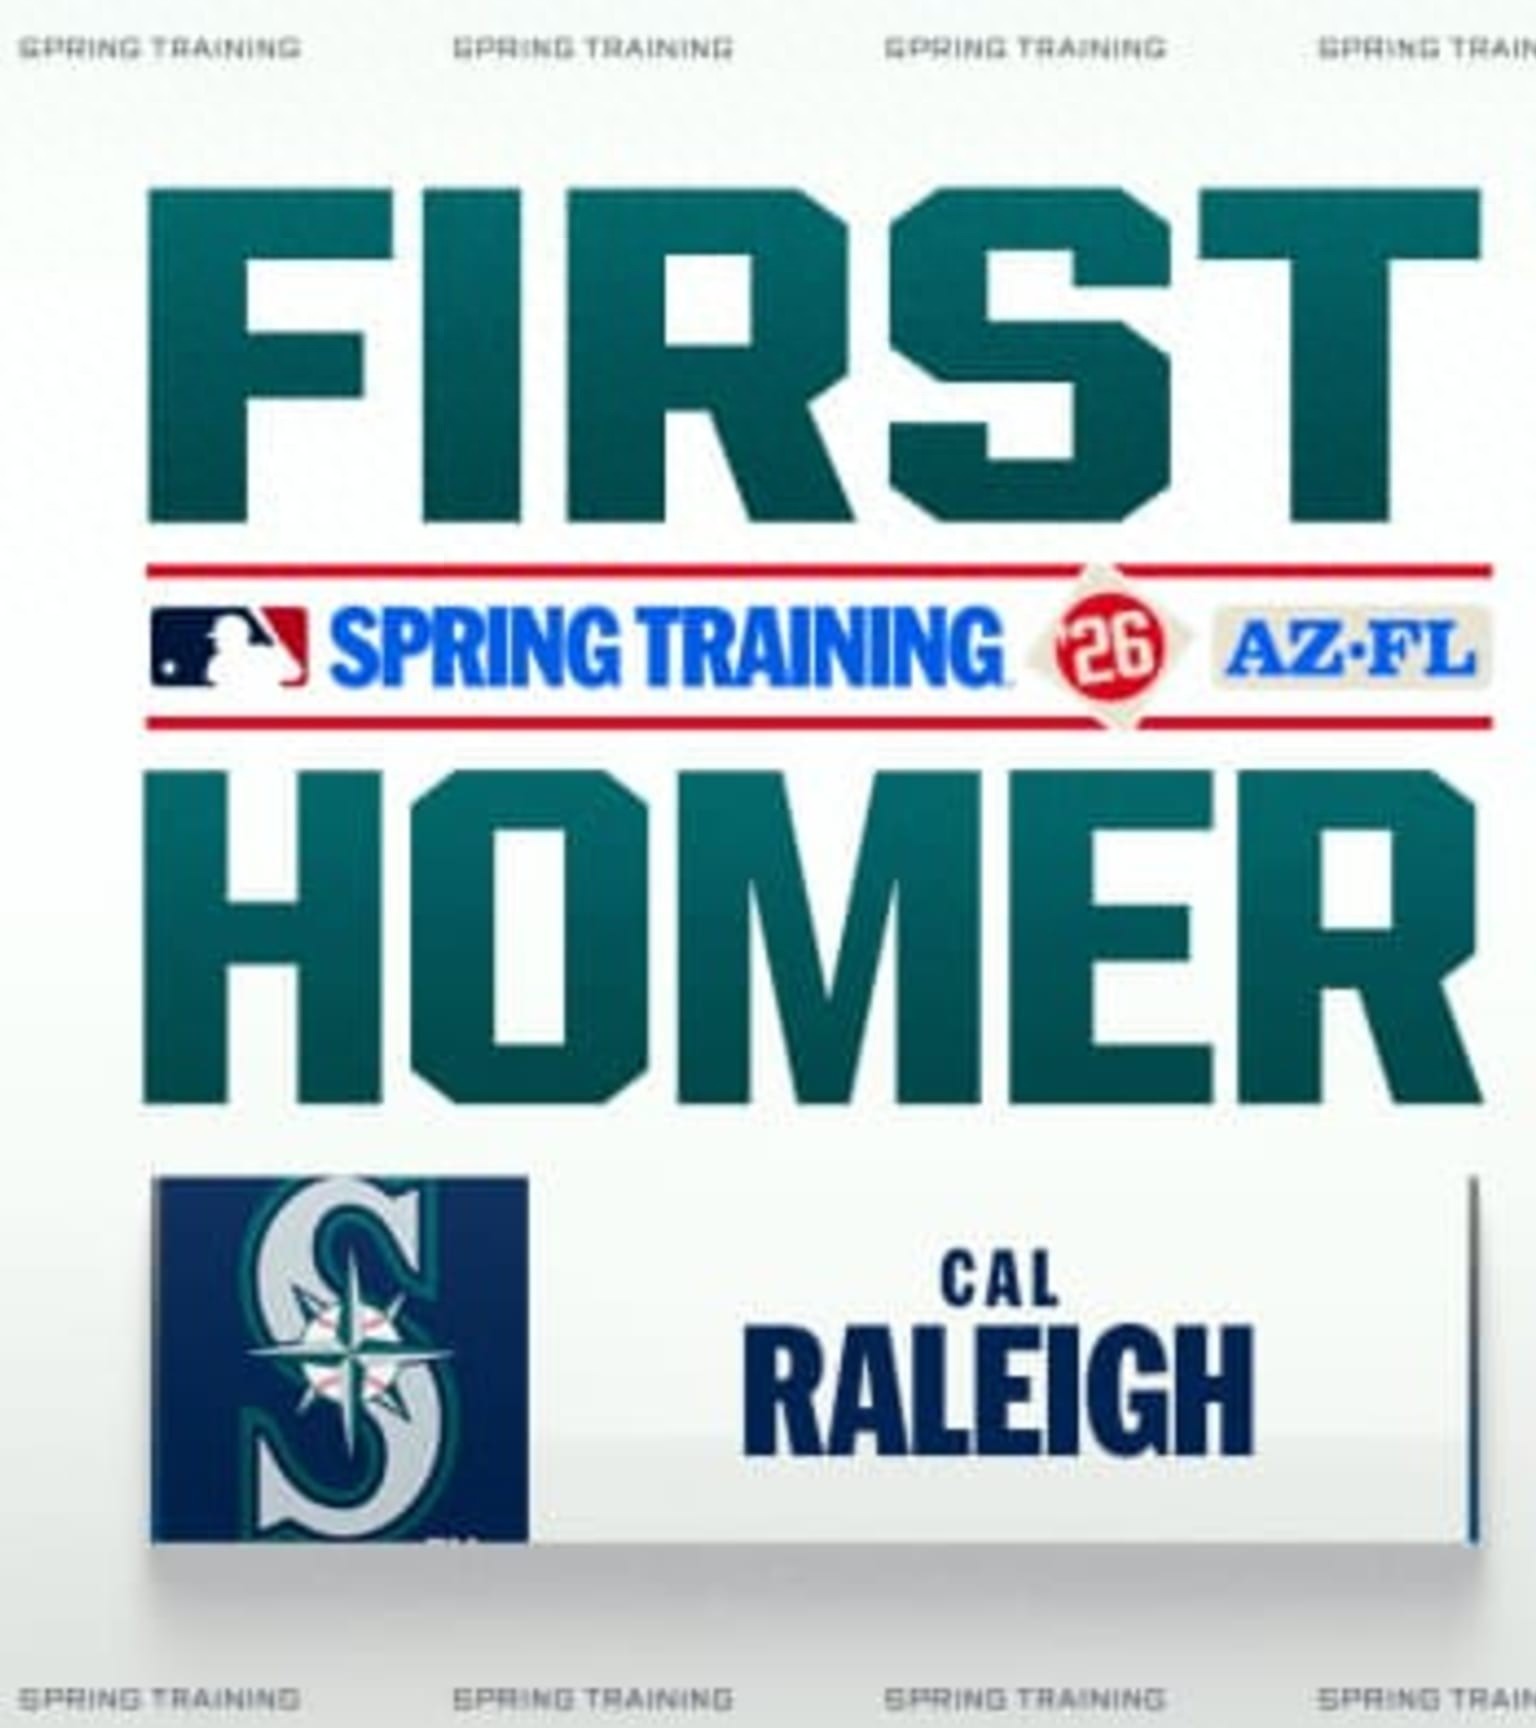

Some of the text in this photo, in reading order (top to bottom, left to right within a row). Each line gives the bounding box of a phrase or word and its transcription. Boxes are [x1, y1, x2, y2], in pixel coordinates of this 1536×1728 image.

[19, 36, 301, 60] SPRING TRAINING
[453, 36, 733, 60] SPRING TRAINING
[884, 36, 1167, 60] SPRING TRAINING
[1318, 36, 1441, 60] SPRING
[148, 187, 1482, 524] FIRST
[329, 605, 1005, 690] SPRING TRAINING
[143, 769, 1484, 1105] HOMER
[941, 1248, 1059, 1308] CAL
[240, 1178, 460, 1542] S
[743, 1322, 1254, 1459] RALEIGH
[18, 1687, 301, 1712] SPRING TRAINING
[453, 1687, 733, 1712] SPRING TRAINING
[883, 1687, 1167, 1712] SPRING TRAINING
[1317, 1687, 1441, 1712] SPRING
